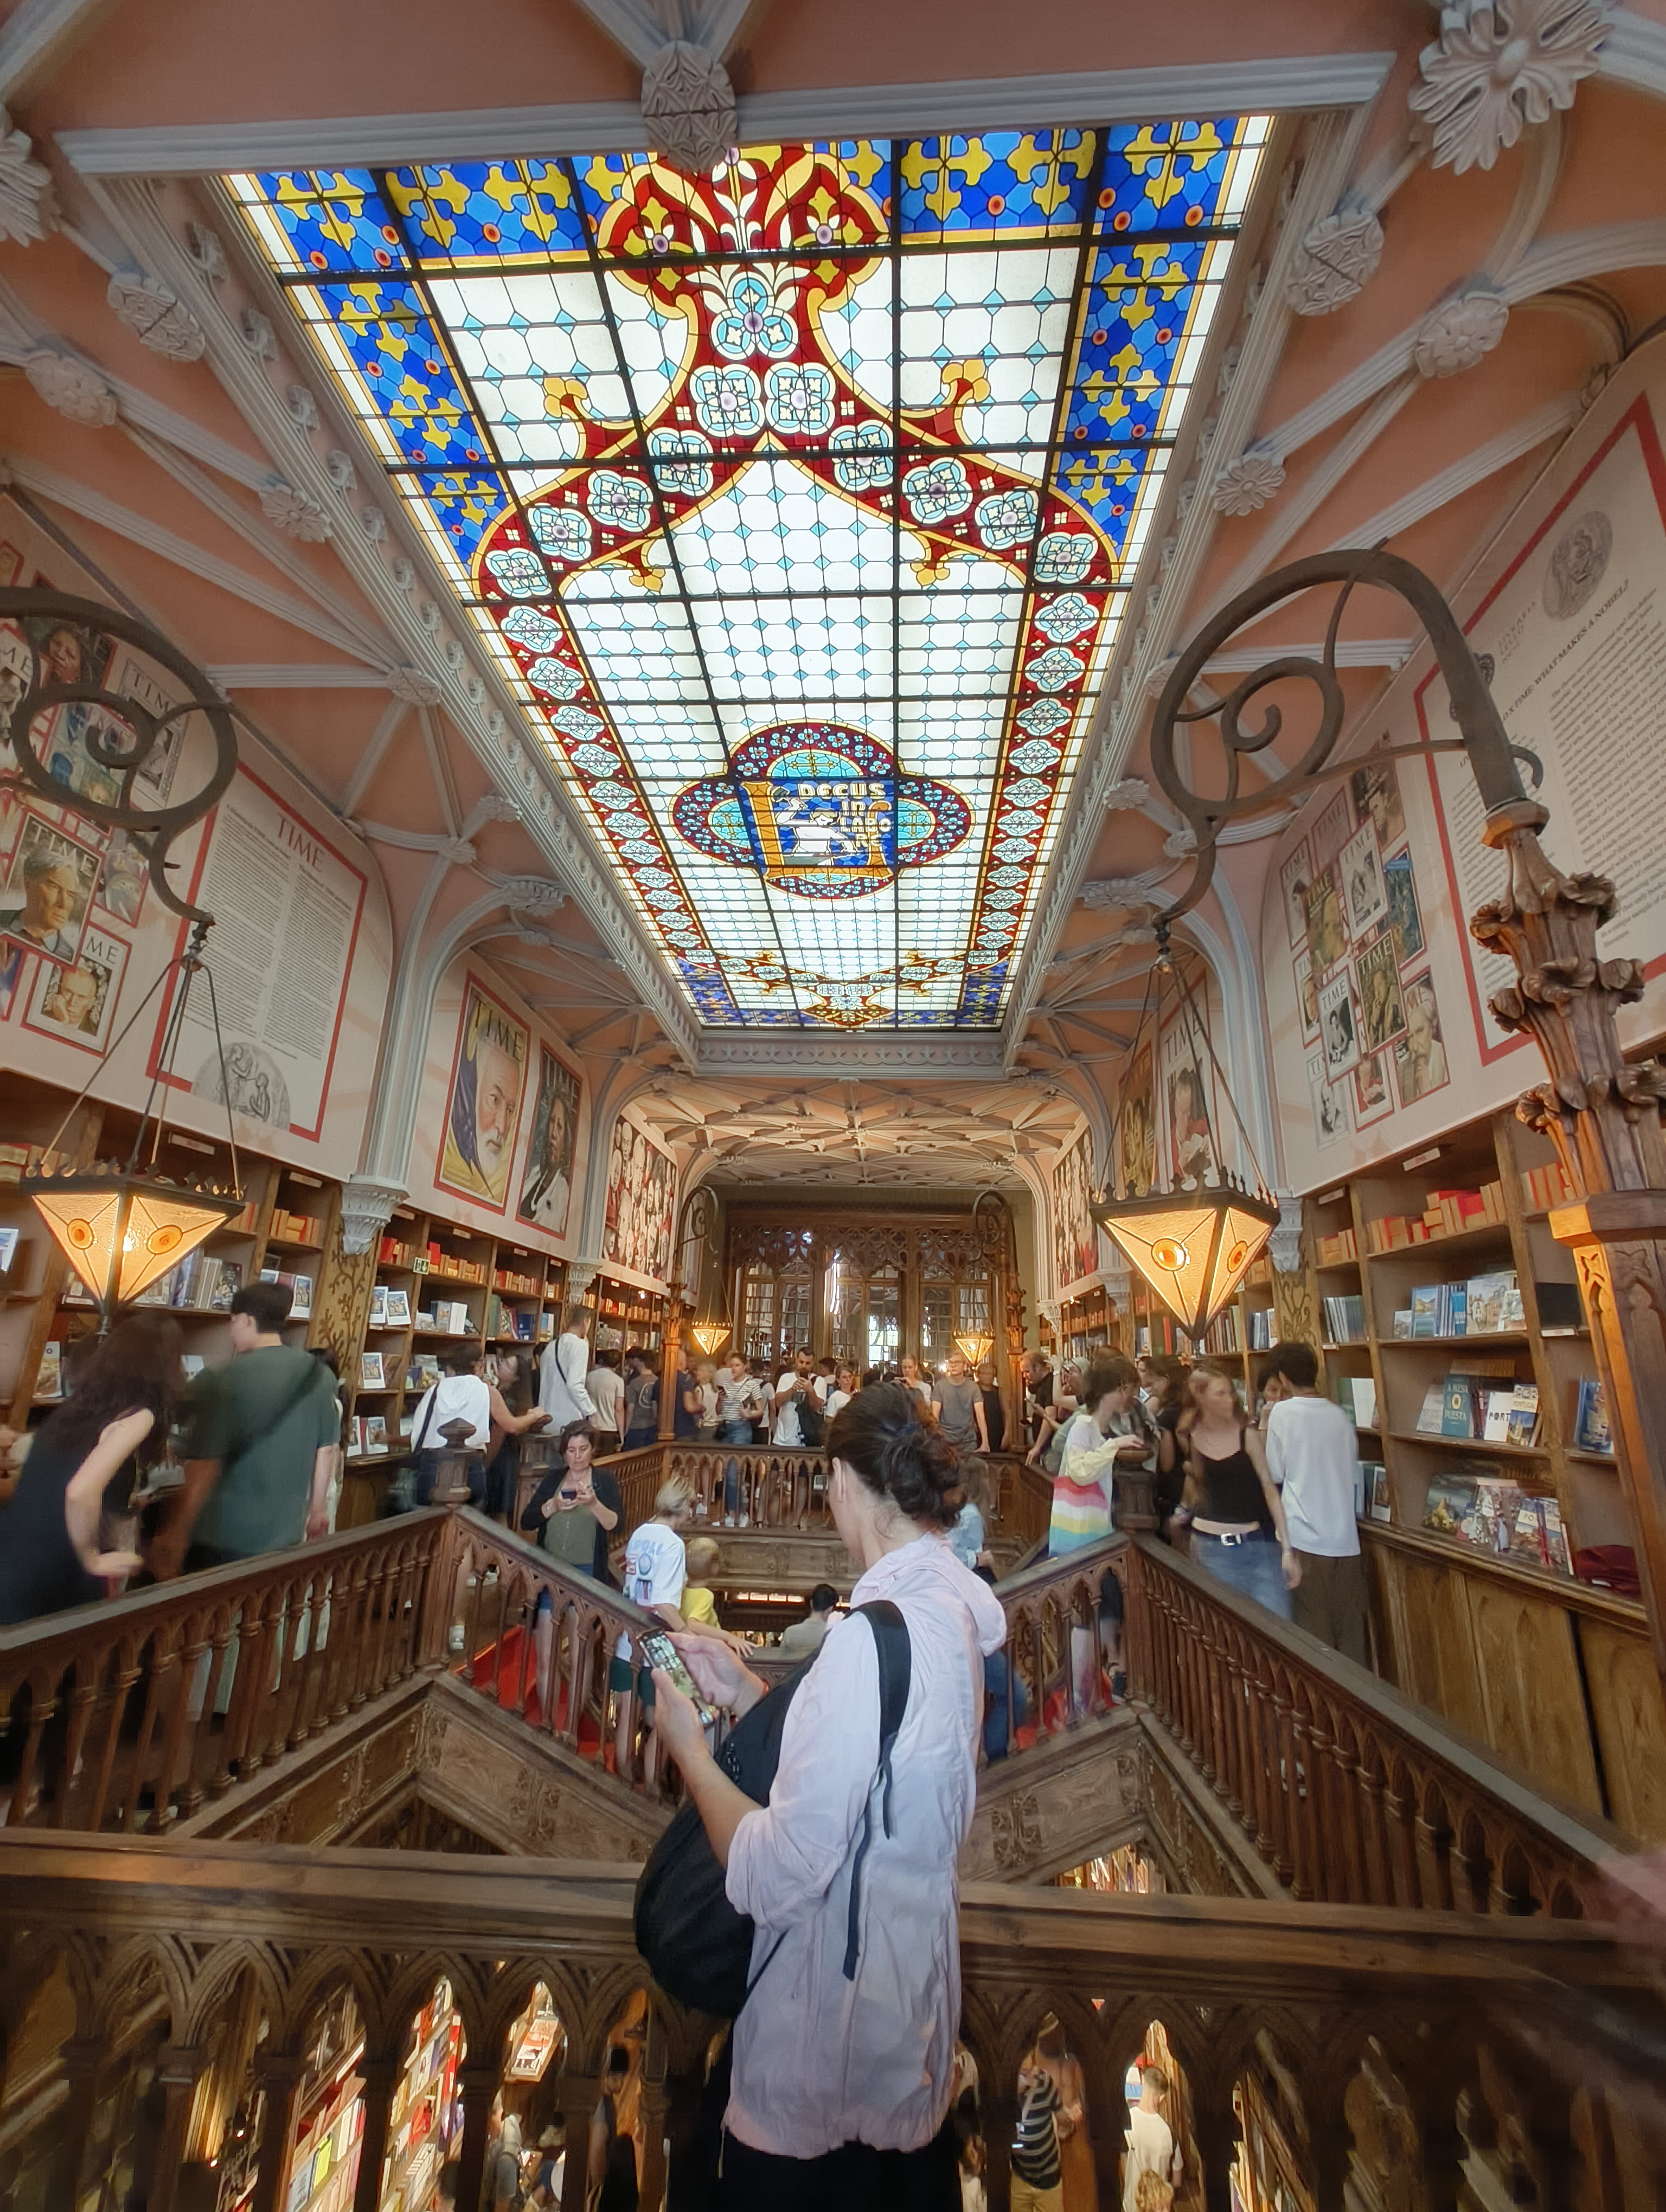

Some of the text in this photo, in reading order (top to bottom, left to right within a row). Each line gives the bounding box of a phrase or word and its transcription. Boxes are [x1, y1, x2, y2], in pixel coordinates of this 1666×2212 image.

[0, 647, 32, 678] ME
[132, 668, 169, 712] TIM
[798, 783, 886, 799] DECUS
[840, 818, 892, 832] LABO
[32, 821, 96, 877] TIME
[277, 813, 324, 873] TIME
[1343, 824, 1373, 864] TIME
[1283, 845, 1307, 880] TIME
[1307, 871, 1331, 907] TIME
[86, 936, 119, 965] ME
[1359, 936, 1392, 976] TIME
[1321, 979, 1347, 1011] TIME
[474, 995, 523, 1063] TIME
[1489, 1412, 1510, 1421] PORT
